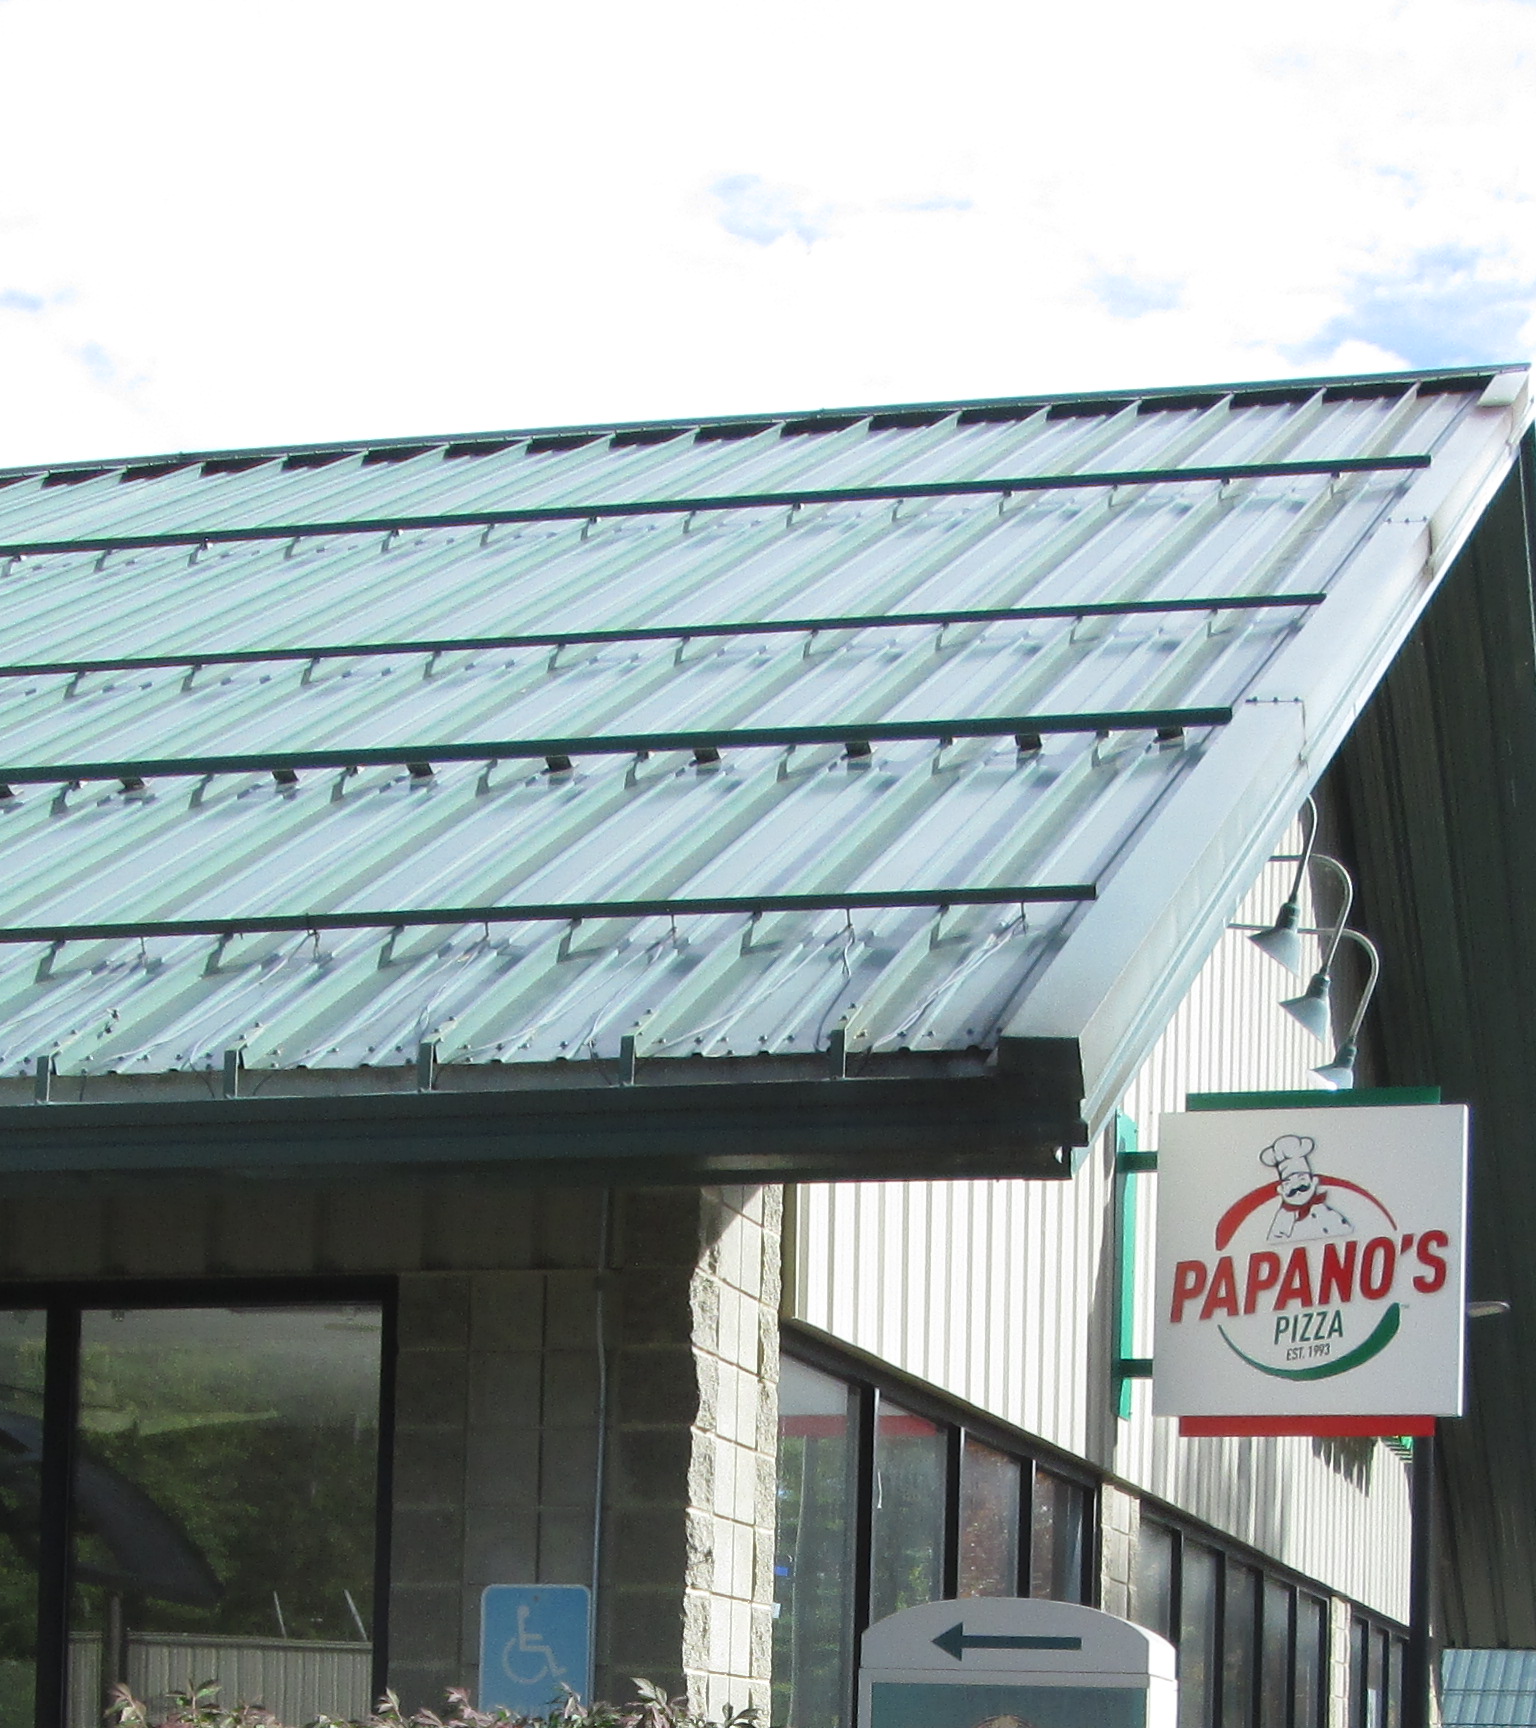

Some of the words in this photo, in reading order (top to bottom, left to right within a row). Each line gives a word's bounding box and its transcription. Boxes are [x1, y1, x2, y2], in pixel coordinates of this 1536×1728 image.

[1170, 1230, 1449, 1323] PAPANO'S
[1274, 1310, 1344, 1345] PIZZA
[1286, 1347, 1306, 1361] EST.
[1308, 1343, 1331, 1358] 1993
